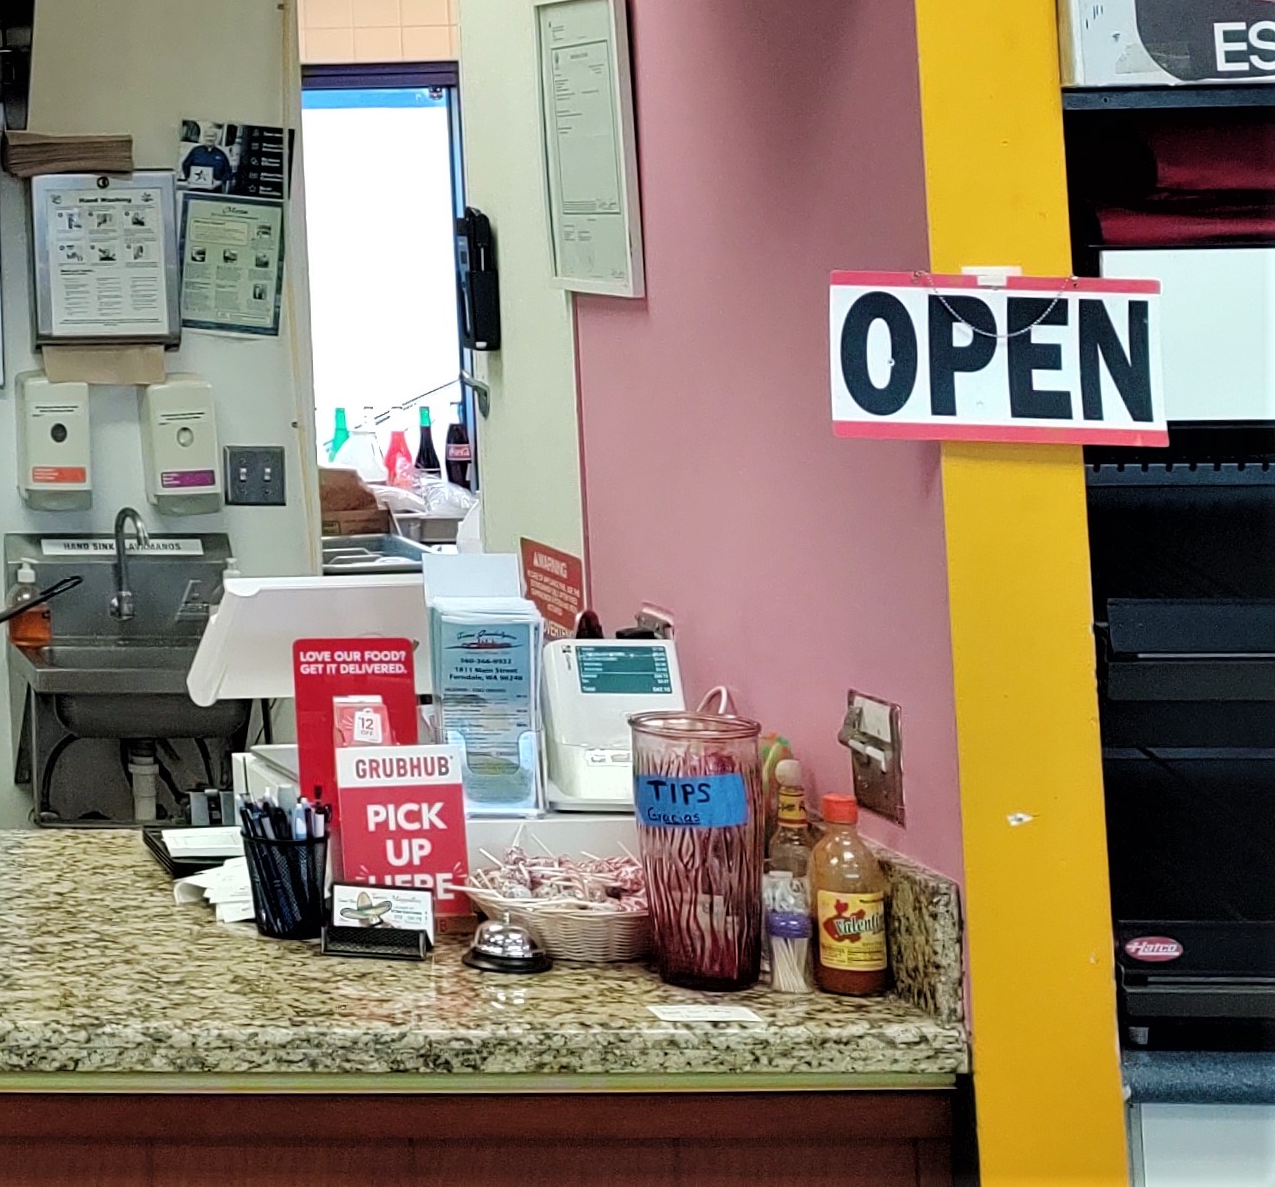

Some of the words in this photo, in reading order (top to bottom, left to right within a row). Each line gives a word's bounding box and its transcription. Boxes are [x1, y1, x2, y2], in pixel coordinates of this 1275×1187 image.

[840, 290, 1155, 423] OPEN
[299, 651, 331, 662] LOVE
[335, 650, 361, 661] OUR
[364, 650, 406, 662] FOOD?
[300, 664, 323, 675] GET
[327, 664, 336, 675] IT
[339, 662, 407, 675] DELIVERED.
[356, 756, 449, 779] GRUBHUB
[647, 780, 711, 803] TIPS
[367, 802, 447, 832] PICK
[647, 807, 700, 824] Gracias
[386, 838, 432, 866] UP
